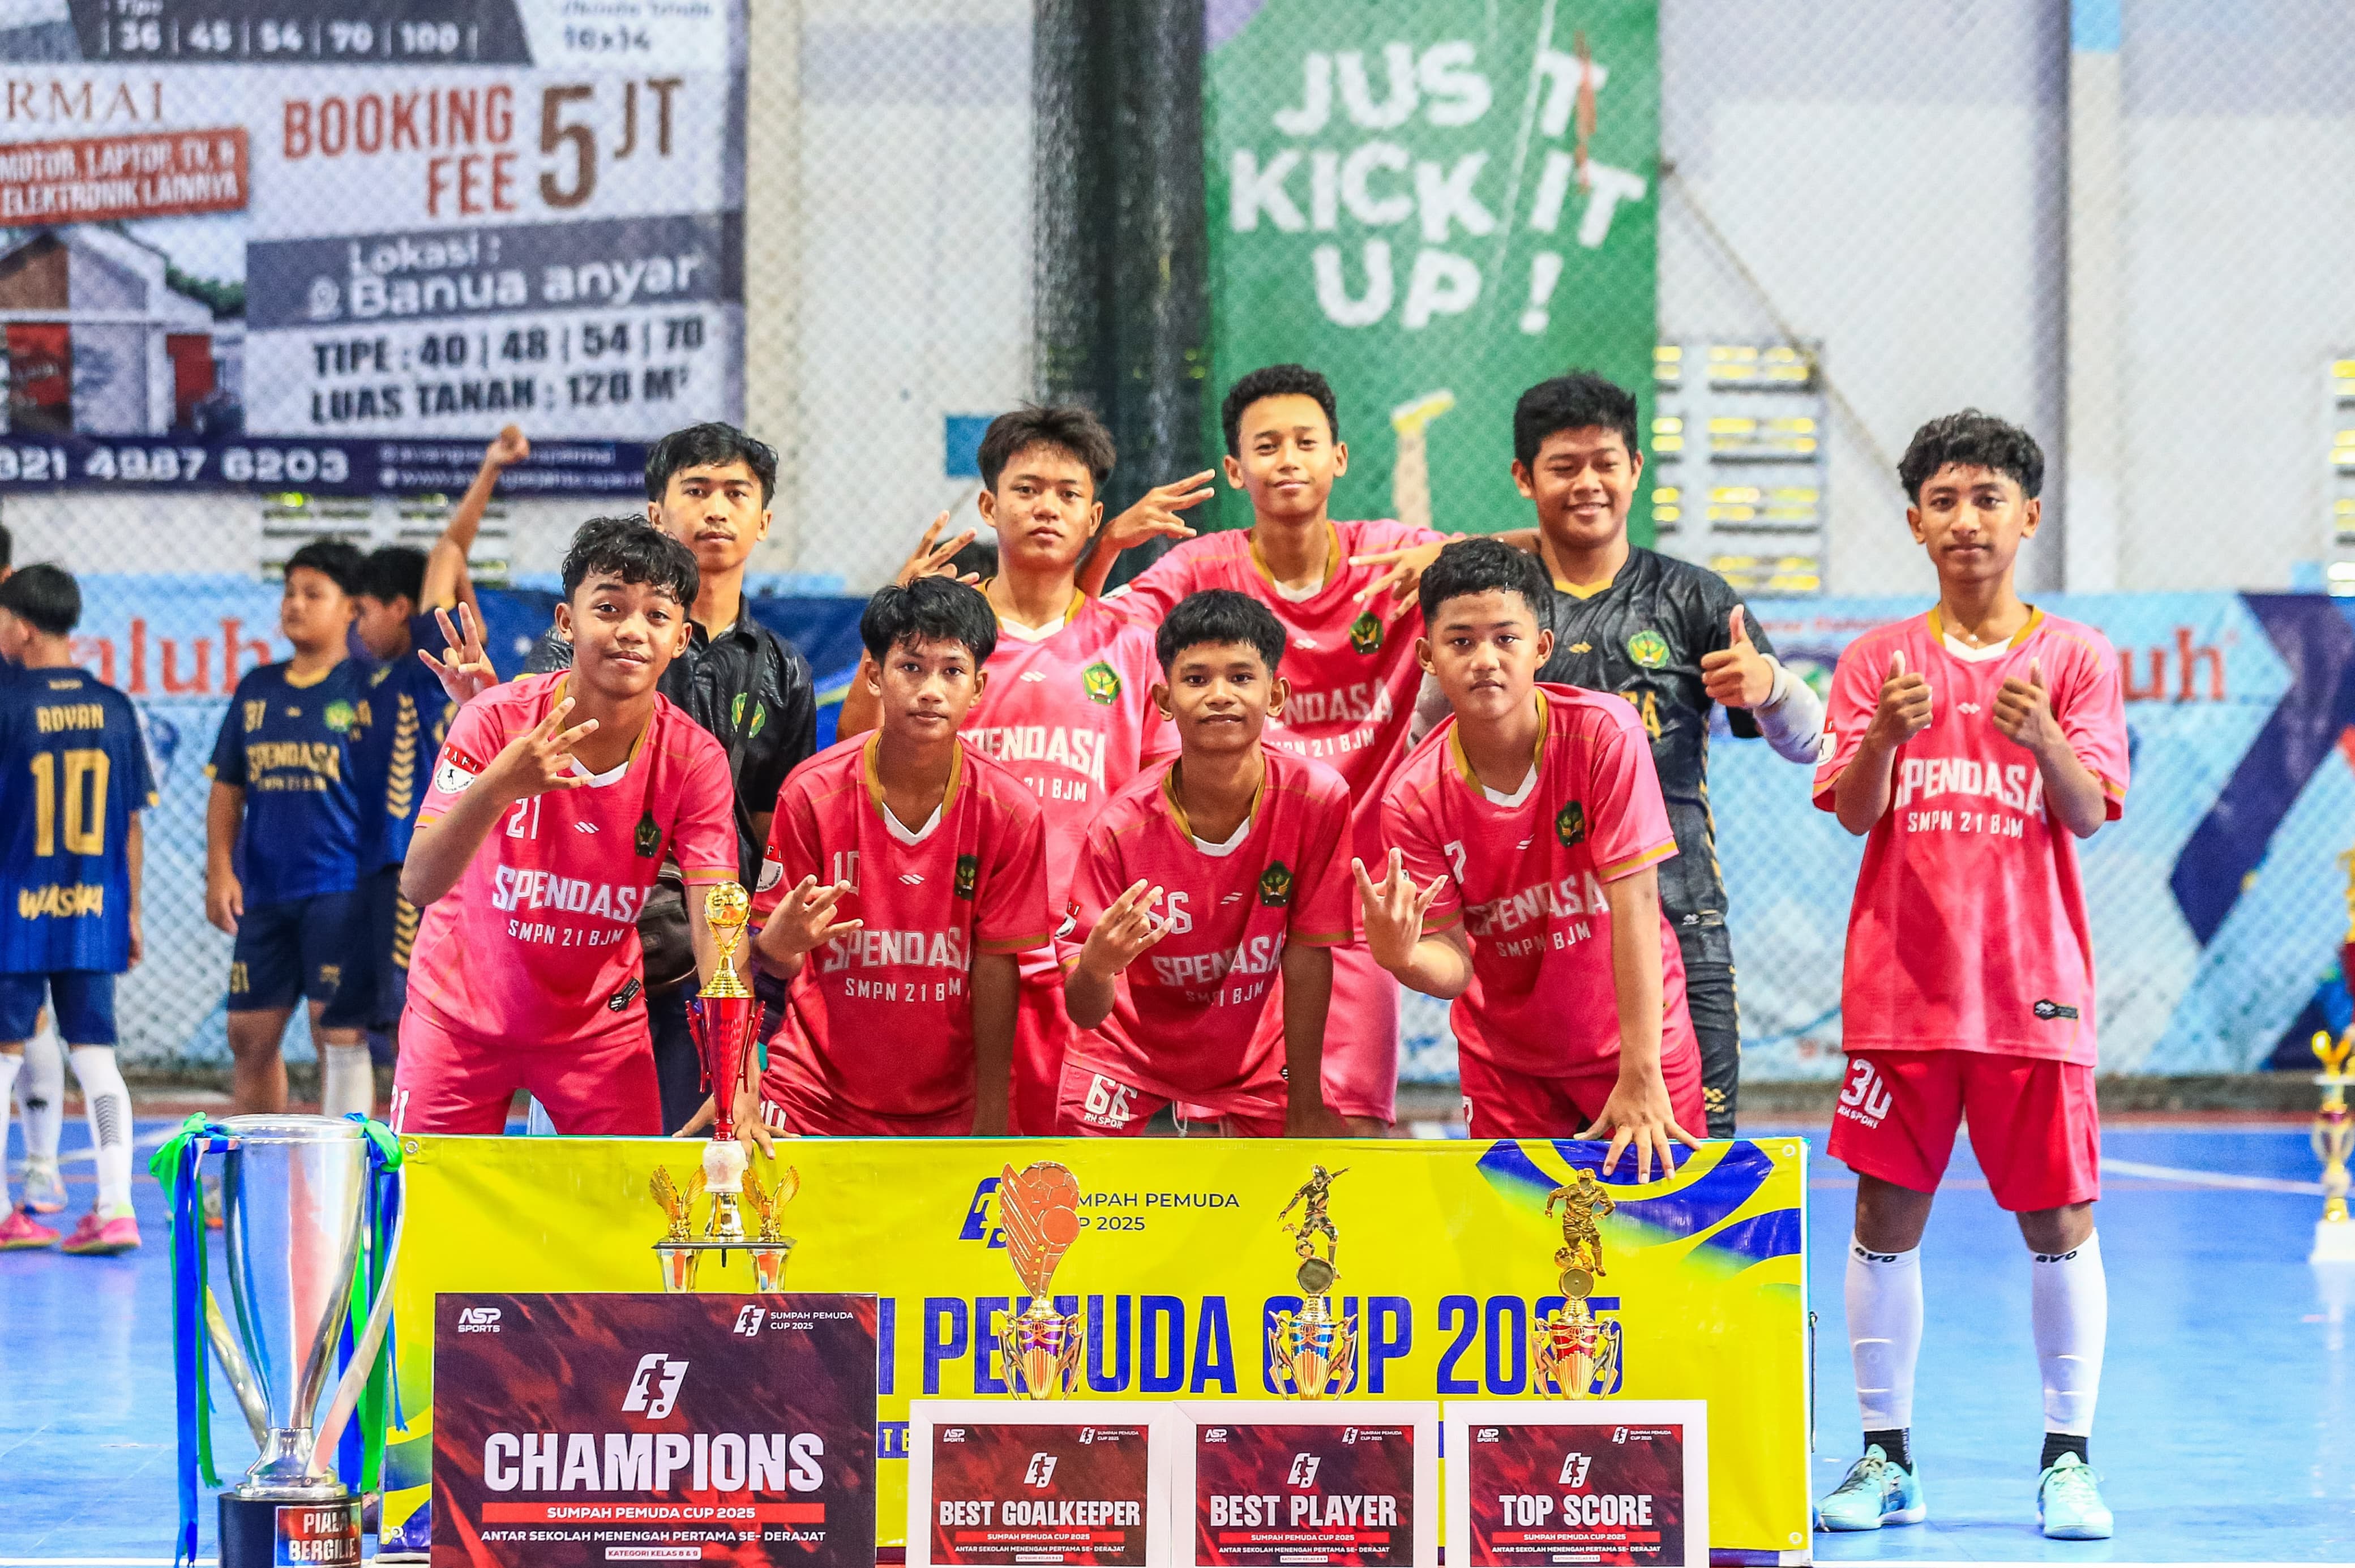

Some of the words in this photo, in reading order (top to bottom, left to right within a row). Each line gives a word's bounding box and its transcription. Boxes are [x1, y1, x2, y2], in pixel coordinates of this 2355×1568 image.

[329, 21, 374, 53] 70
[7, 80, 163, 121] RMAI
[1273, 40, 1609, 138] JUST
[283, 83, 513, 161] BOOKING
[539, 83, 598, 209] 5
[614, 76, 686, 161] JT
[425, 152, 519, 218] FEE
[1229, 140, 1498, 243] KICK
[1529, 148, 1647, 249] IT
[349, 268, 529, 318] Banua
[543, 254, 702, 306] anyar
[1311, 238, 1480, 330] UP
[665, 314, 705, 350] 70
[1311, 738, 1334, 757] 21
[1338, 727, 1375, 753] BJM
[31, 748, 110, 856] 10
[1052, 778, 1087, 802] BJM
[506, 794, 542, 840] 21
[1907, 810, 1953, 833] SMPN
[1959, 811, 1983, 833] 21
[1444, 839, 1467, 884] 7
[508, 919, 556, 945] SMPN
[562, 928, 583, 946] 21
[588, 929, 624, 946] BJM
[1552, 920, 1592, 950] BJM
[845, 977, 897, 1002] SMPN
[905, 983, 927, 1003] 21
[1232, 979, 1264, 1005] BJM
[1085, 1073, 1138, 1121] 66
[1098, 1116, 1125, 1130] SPOR
[1080, 1193, 1138, 1207] MPAH
[1145, 1193, 1240, 1207] PEMUDA
[1097, 1216, 1146, 1231] 2025
[457, 1307, 502, 1325] ASP
[457, 1325, 501, 1333] SPORTS
[770, 1311, 811, 1319] SUMPAH
[812, 1311, 854, 1319] PEMUDA
[943, 1429, 966, 1438] ASP
[1205, 1429, 1228, 1438] ASP
[1477, 1428, 1500, 1437] ASP
[483, 1430, 826, 1493] CHAMPIONS
[547, 1507, 612, 1519] SUMPAH
[615, 1507, 680, 1519] PEMUDA
[683, 1507, 714, 1519] CUP
[716, 1507, 756, 1519] 2025
[939, 1500, 995, 1527] BEST
[1002, 1500, 1141, 1527] GOALKEEPER
[1210, 1494, 1281, 1527] BEST
[1290, 1494, 1398, 1527] PLAYER
[1498, 1494, 1554, 1527] TOP
[1562, 1494, 1653, 1527] SCORE
[481, 1531, 526, 1541] ANTAR
[529, 1531, 591, 1541] SEKOLAH
[594, 1531, 670, 1541] MENENGAH
[672, 1531, 736, 1541] PERTAMA
[739, 1531, 761, 1541] SE-
[764, 1531, 826, 1541] DERAJAT
